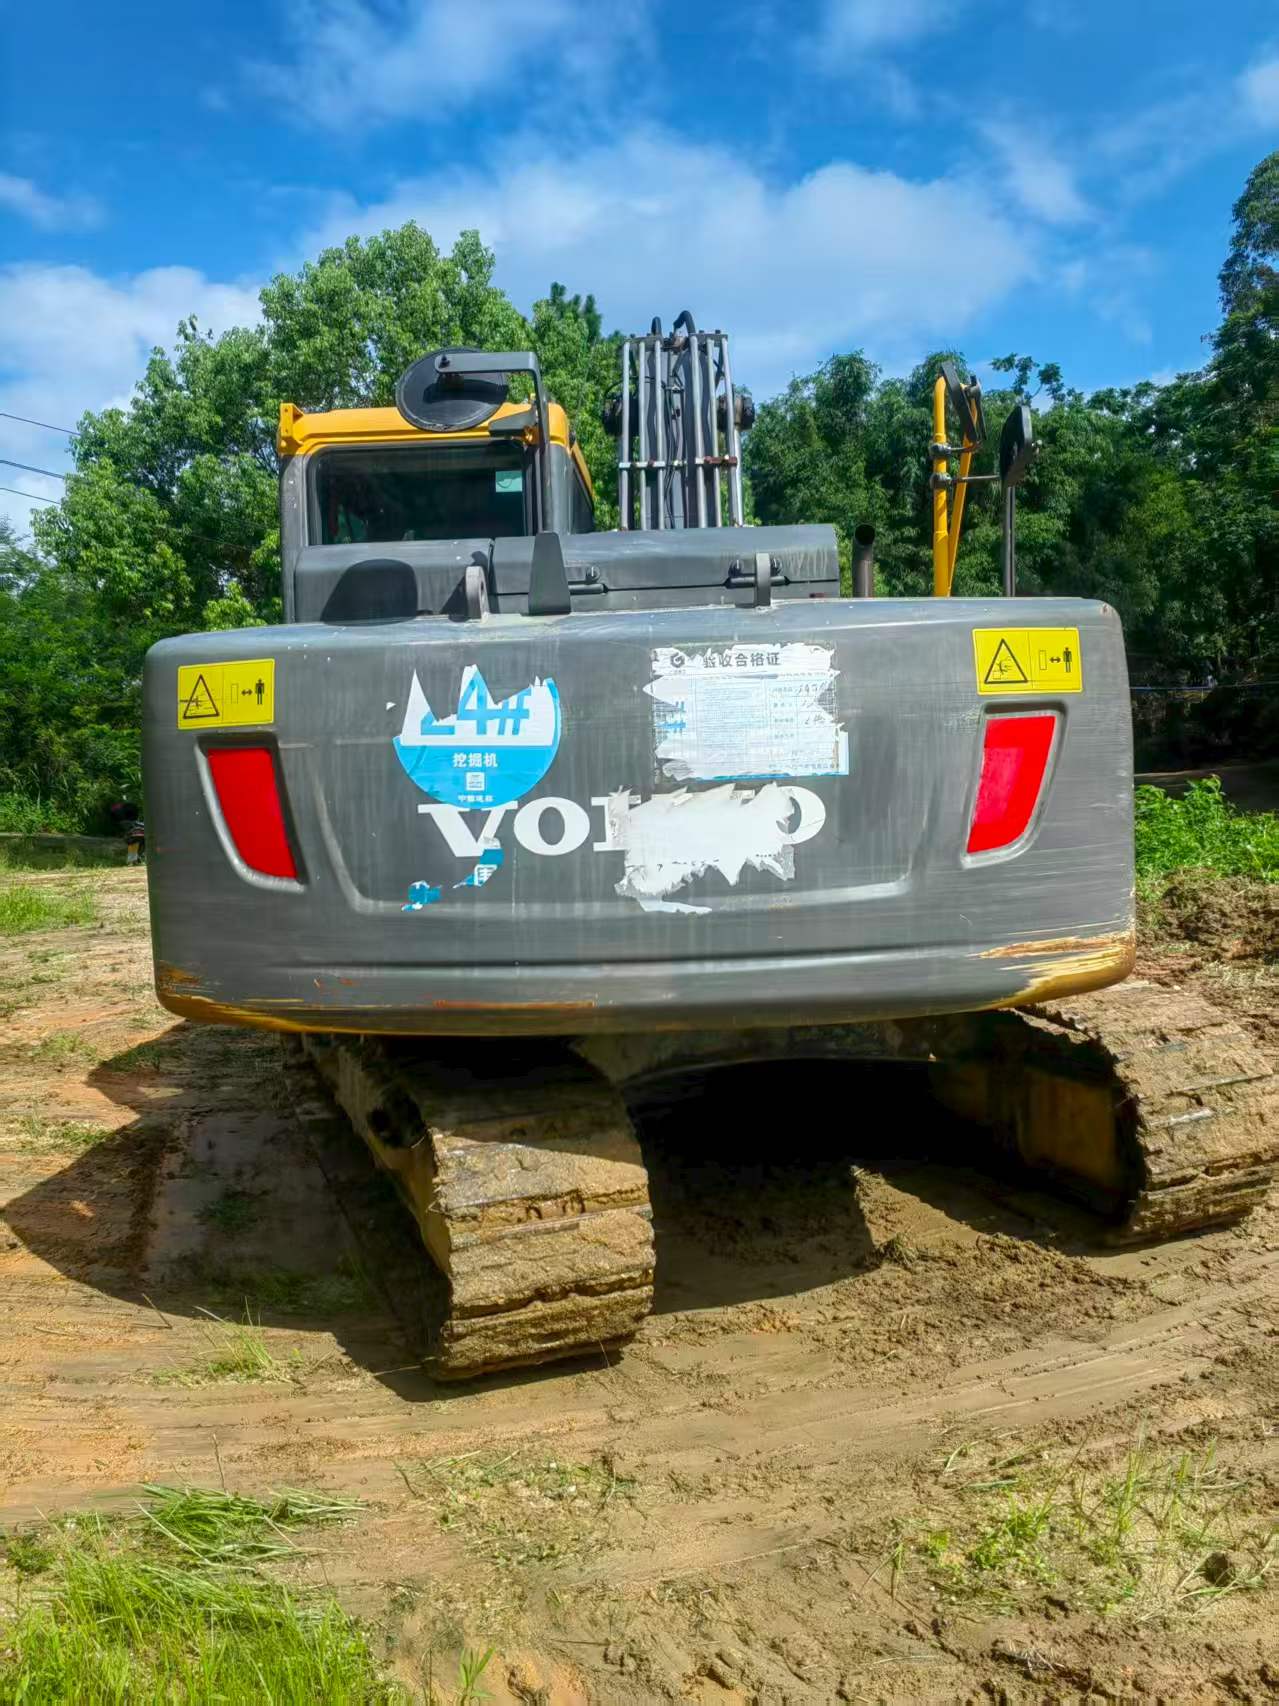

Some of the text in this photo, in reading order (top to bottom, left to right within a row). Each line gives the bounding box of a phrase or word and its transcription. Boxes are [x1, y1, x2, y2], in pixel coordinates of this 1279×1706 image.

[453, 752, 498, 768] 挖掘机
[418, 786, 826, 857] VOLO
